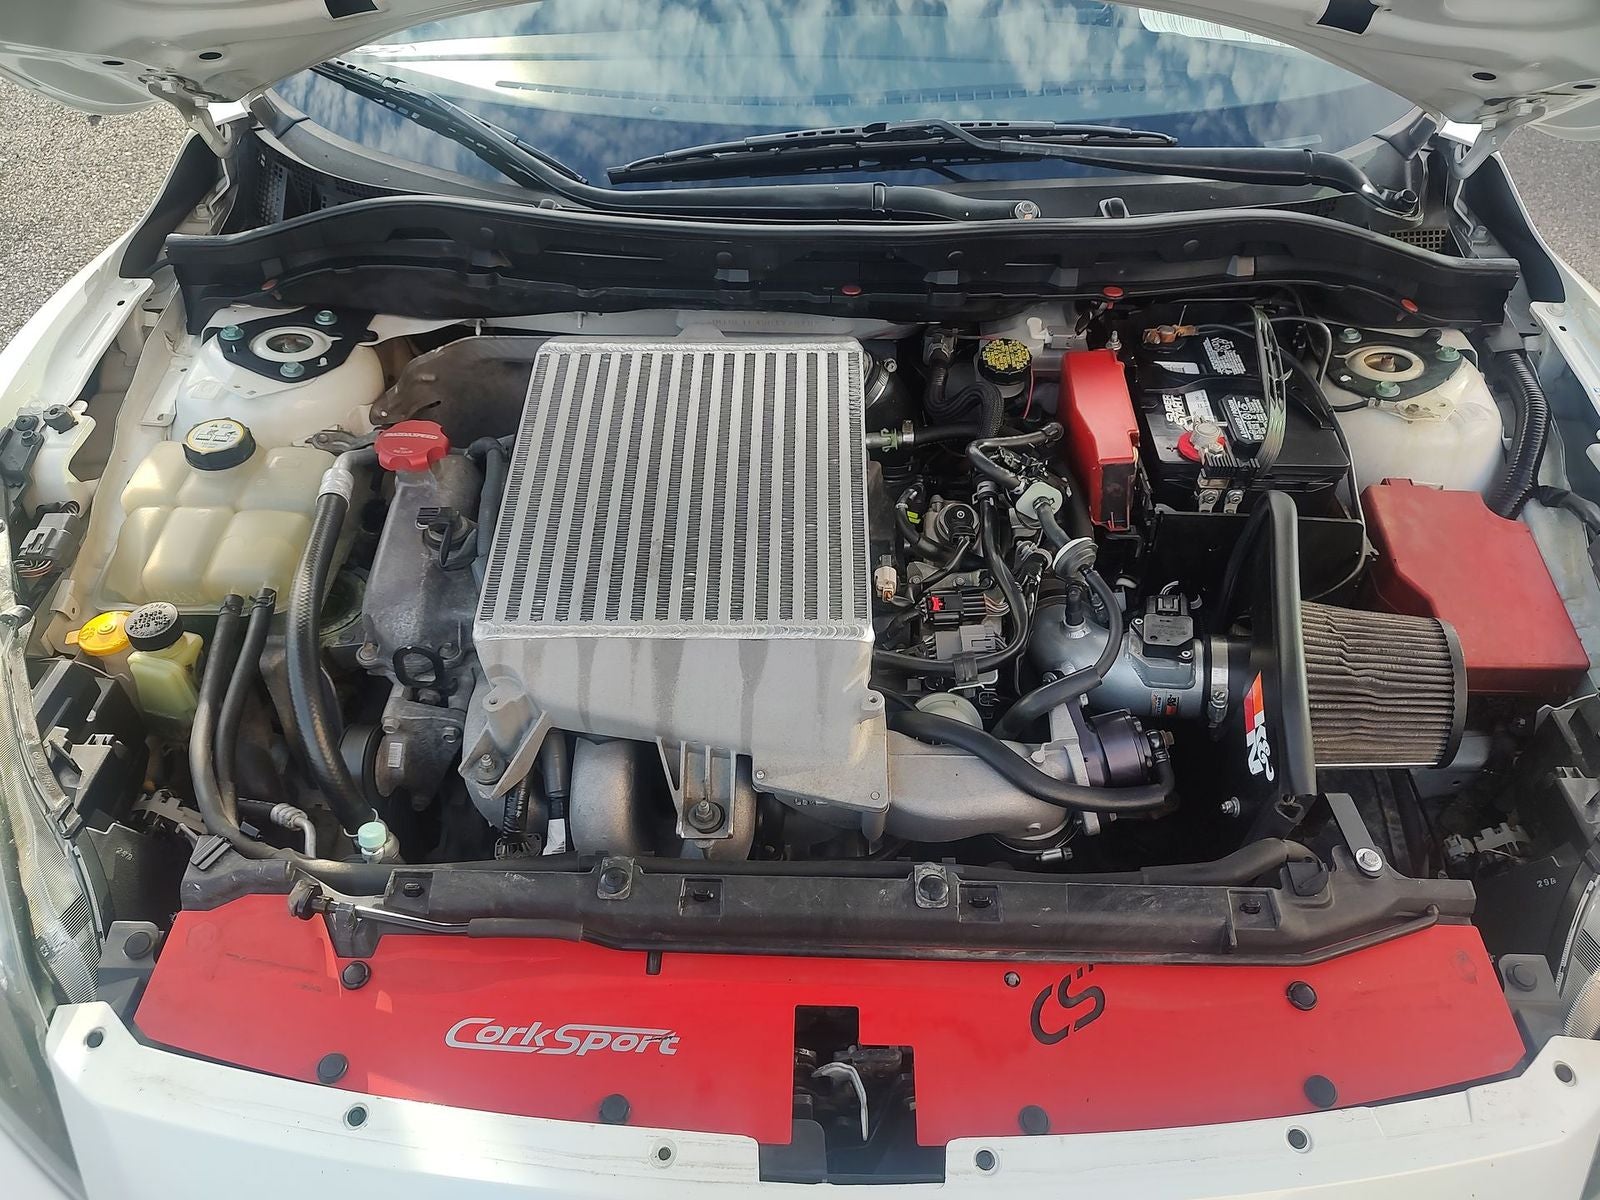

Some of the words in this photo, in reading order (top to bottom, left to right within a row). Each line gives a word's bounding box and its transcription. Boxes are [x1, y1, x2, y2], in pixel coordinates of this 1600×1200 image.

[1162, 394, 1174, 422] SUPER
[1171, 394, 1185, 426] START
[1245, 710, 1275, 782] K&N
[444, 1017, 681, 1056] CorkSport
